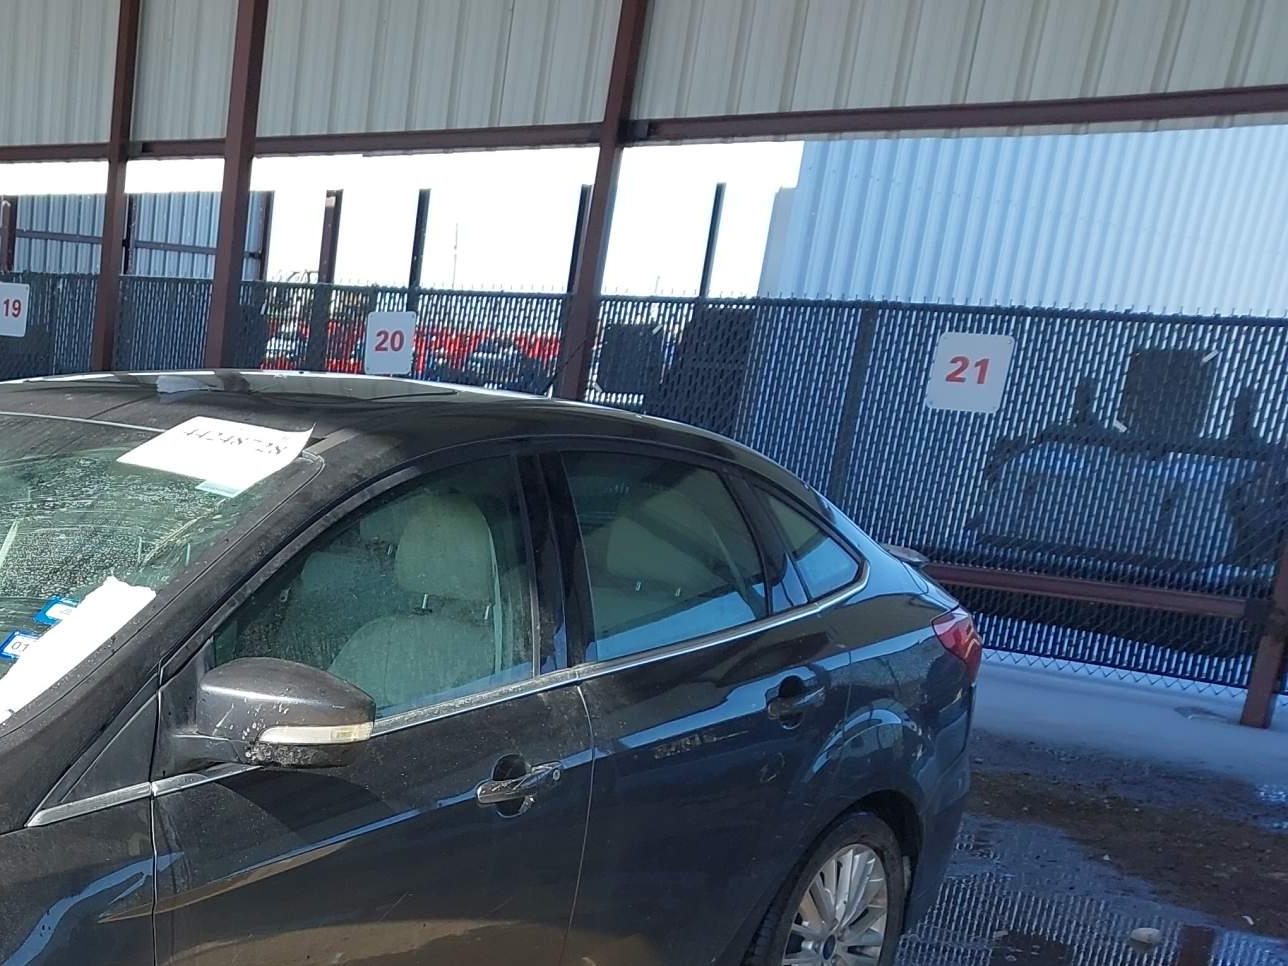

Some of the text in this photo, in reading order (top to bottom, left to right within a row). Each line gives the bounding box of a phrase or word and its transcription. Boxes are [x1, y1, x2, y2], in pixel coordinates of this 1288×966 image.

[3, 299, 21, 318] 19
[374, 330, 405, 352] 20
[944, 355, 991, 385] 21
